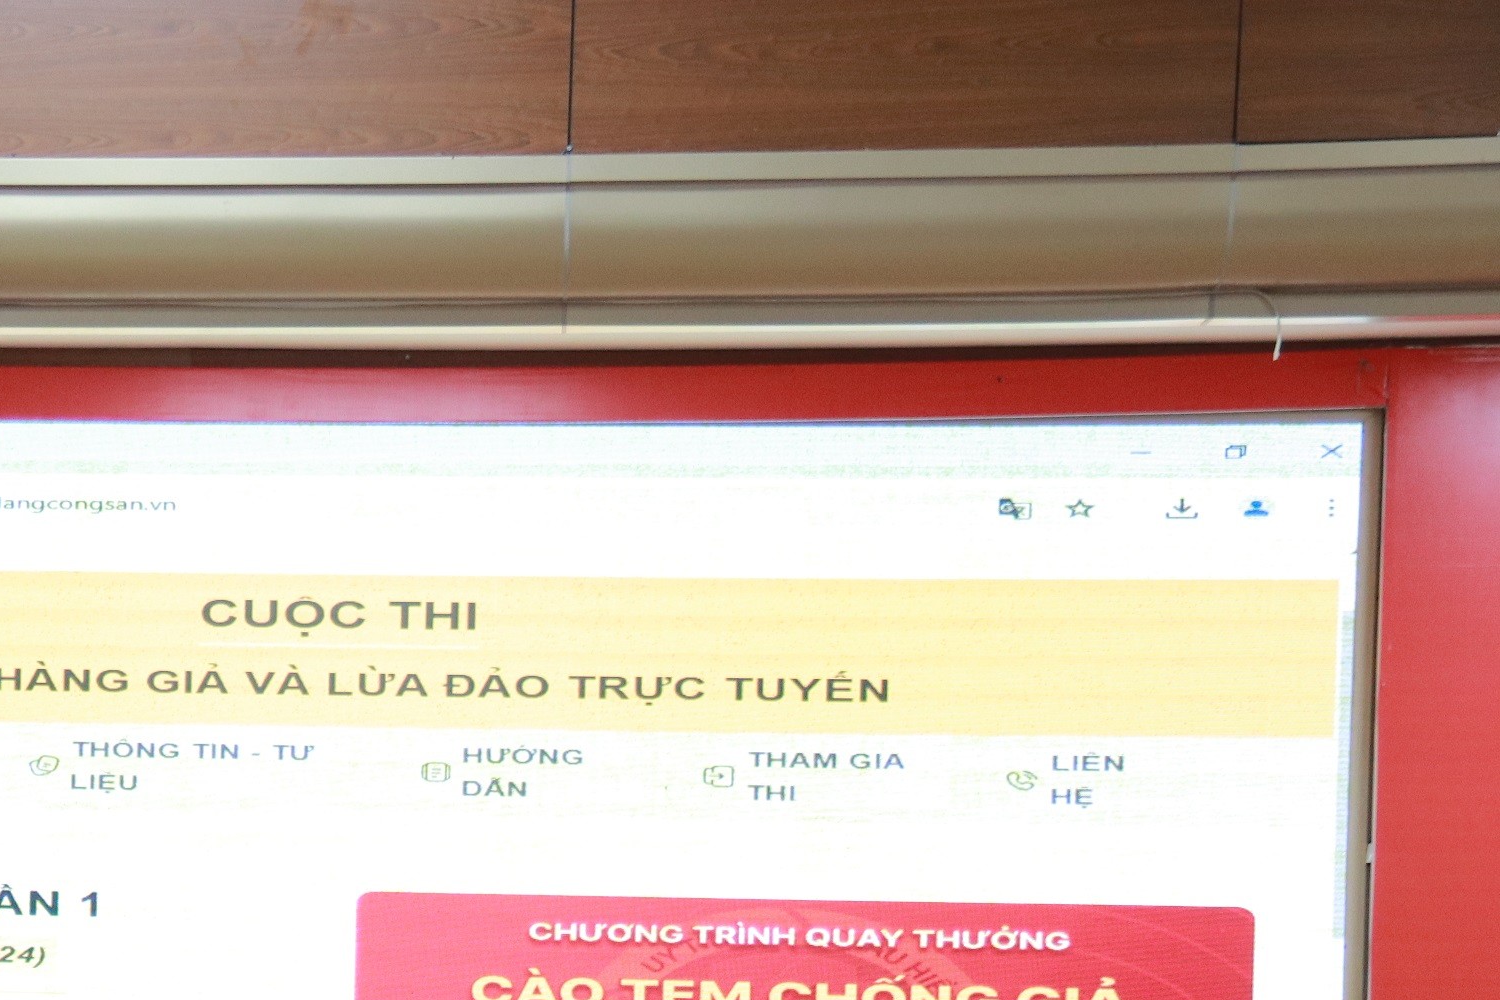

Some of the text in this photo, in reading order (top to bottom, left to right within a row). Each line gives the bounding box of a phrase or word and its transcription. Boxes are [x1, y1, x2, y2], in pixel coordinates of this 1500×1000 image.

[201, 595, 477, 638] CUỘC THI
[146, 662, 229, 695] GIẢ
[244, 663, 310, 696] VÀ
[328, 664, 429, 698] LỪA
[442, 666, 550, 699] ĐẢO
[568, 675, 705, 707] TRỰC
[725, 670, 889, 704] TUYẾN
[72, 738, 180, 759] THÔNG
[193, 743, 239, 760] TIN
[273, 744, 315, 761] TƯ
[463, 747, 583, 766] HƯỚNG
[749, 751, 905, 771] THAM GIA
[1052, 751, 1125, 772] LIÊN
[70, 773, 138, 794] LIỆU
[462, 776, 527, 798] DẪN
[748, 784, 795, 802] THI
[1051, 786, 1093, 809] HỆ
[80, 890, 100, 918] 1
[528, 919, 1071, 952] CHƯƠNG TRÌNH QUAY THƯỞNG
